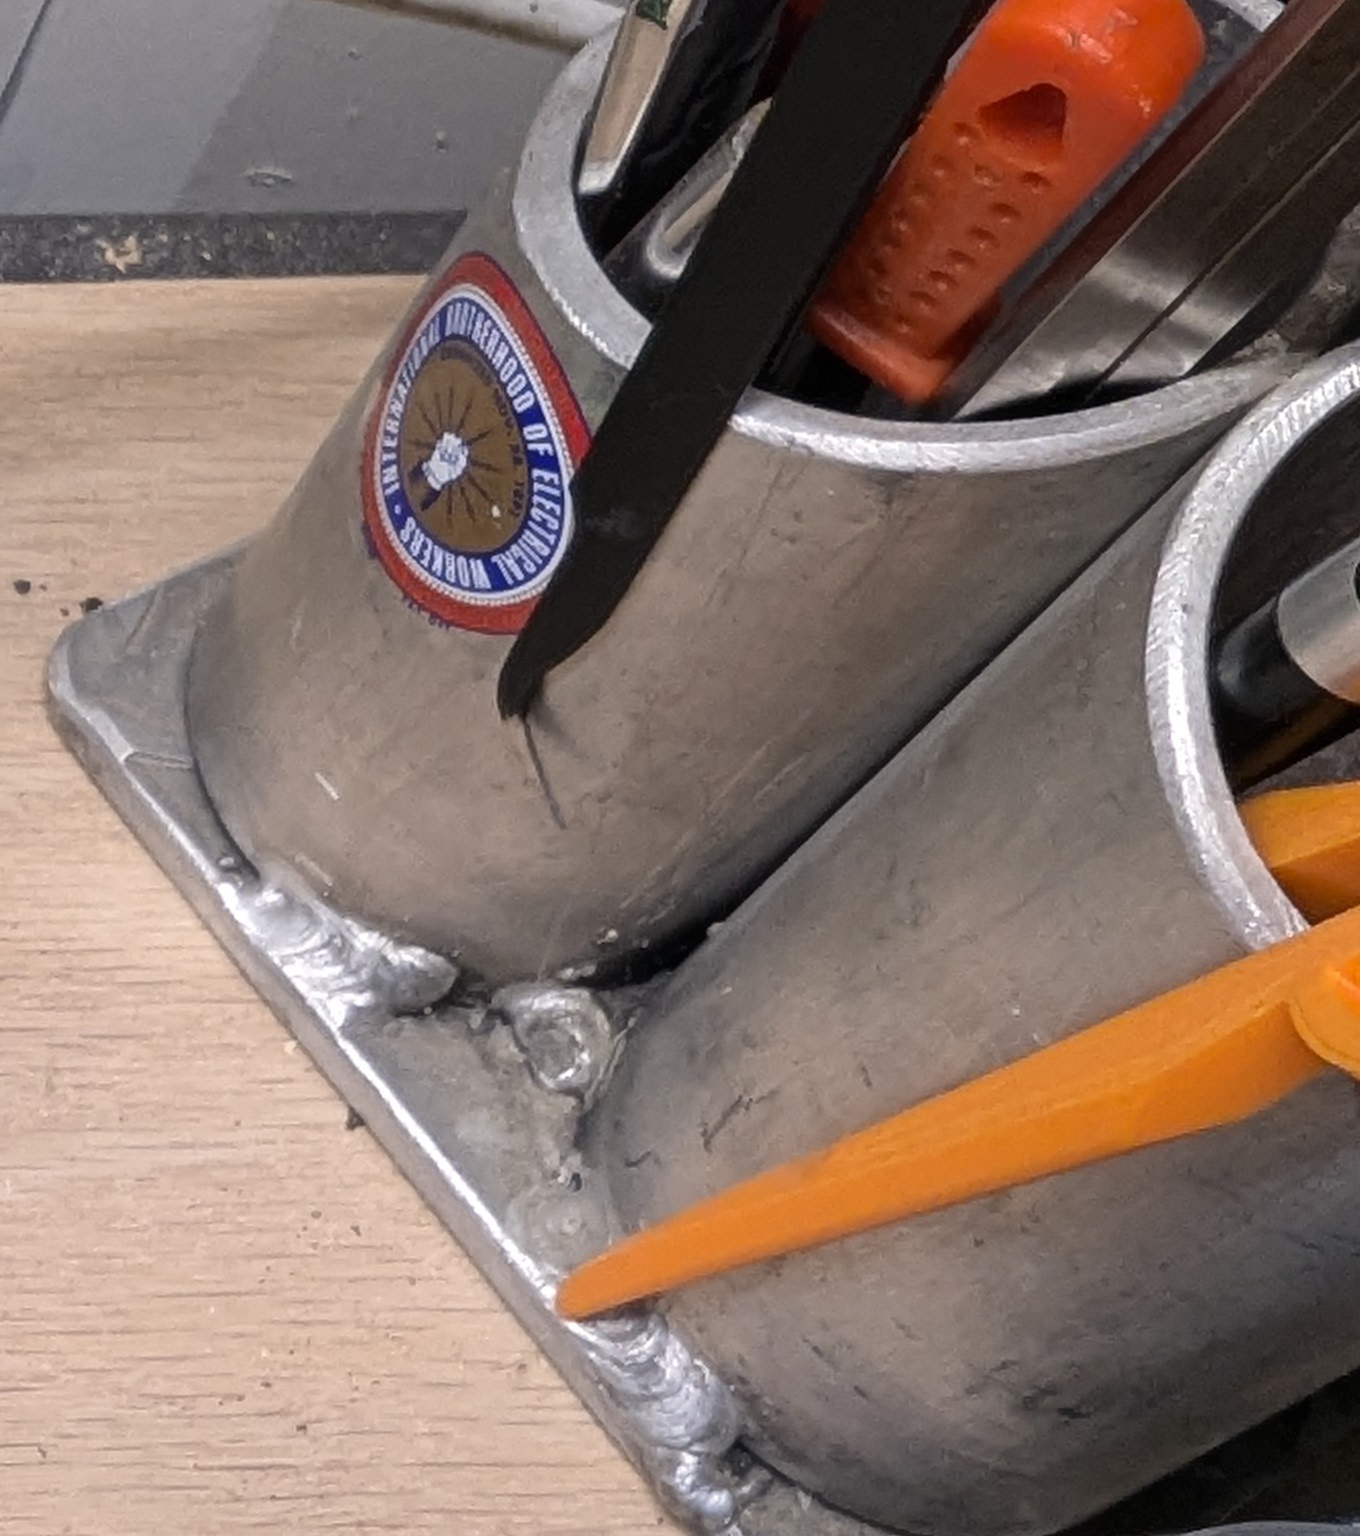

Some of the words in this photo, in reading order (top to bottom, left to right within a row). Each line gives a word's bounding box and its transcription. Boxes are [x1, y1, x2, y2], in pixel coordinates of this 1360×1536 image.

[444, 302, 535, 414] BROTHERHOOD
[522, 422, 555, 457] OF
[399, 516, 492, 589] WORKERS
[490, 468, 562, 587] ELECTRICAL
